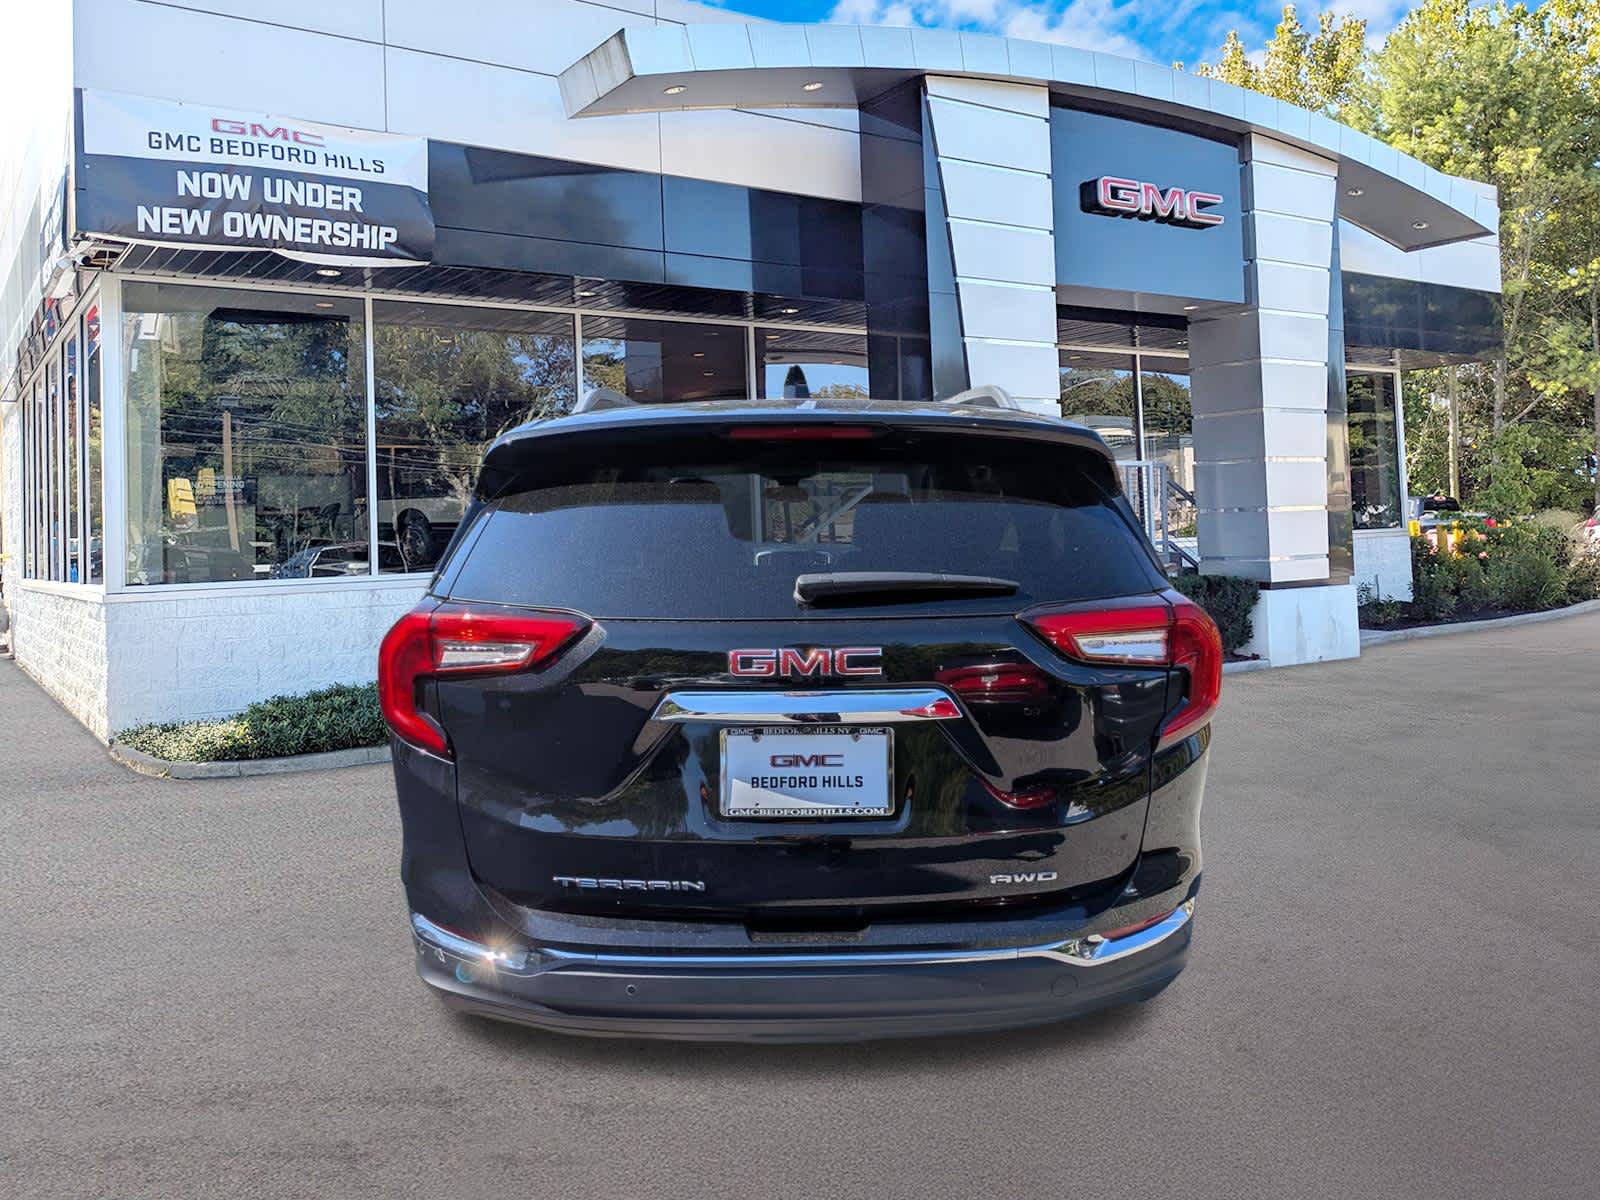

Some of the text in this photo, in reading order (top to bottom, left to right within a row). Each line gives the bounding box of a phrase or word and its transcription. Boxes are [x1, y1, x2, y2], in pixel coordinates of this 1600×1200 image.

[211, 117, 326, 148] GMC
[148, 131, 385, 174] GMC BEDFORD HILLS
[177, 169, 364, 213] NOW UNDER
[1090, 175, 1225, 225] GMC
[137, 205, 399, 251] NEW OWNERSHIP
[729, 648, 882, 677] GMC
[770, 754, 844, 768] GMC
[751, 775, 864, 789] BEDFORD HILLS
[552, 876, 705, 892] TERRAIN
[990, 872, 1058, 884] AWD
